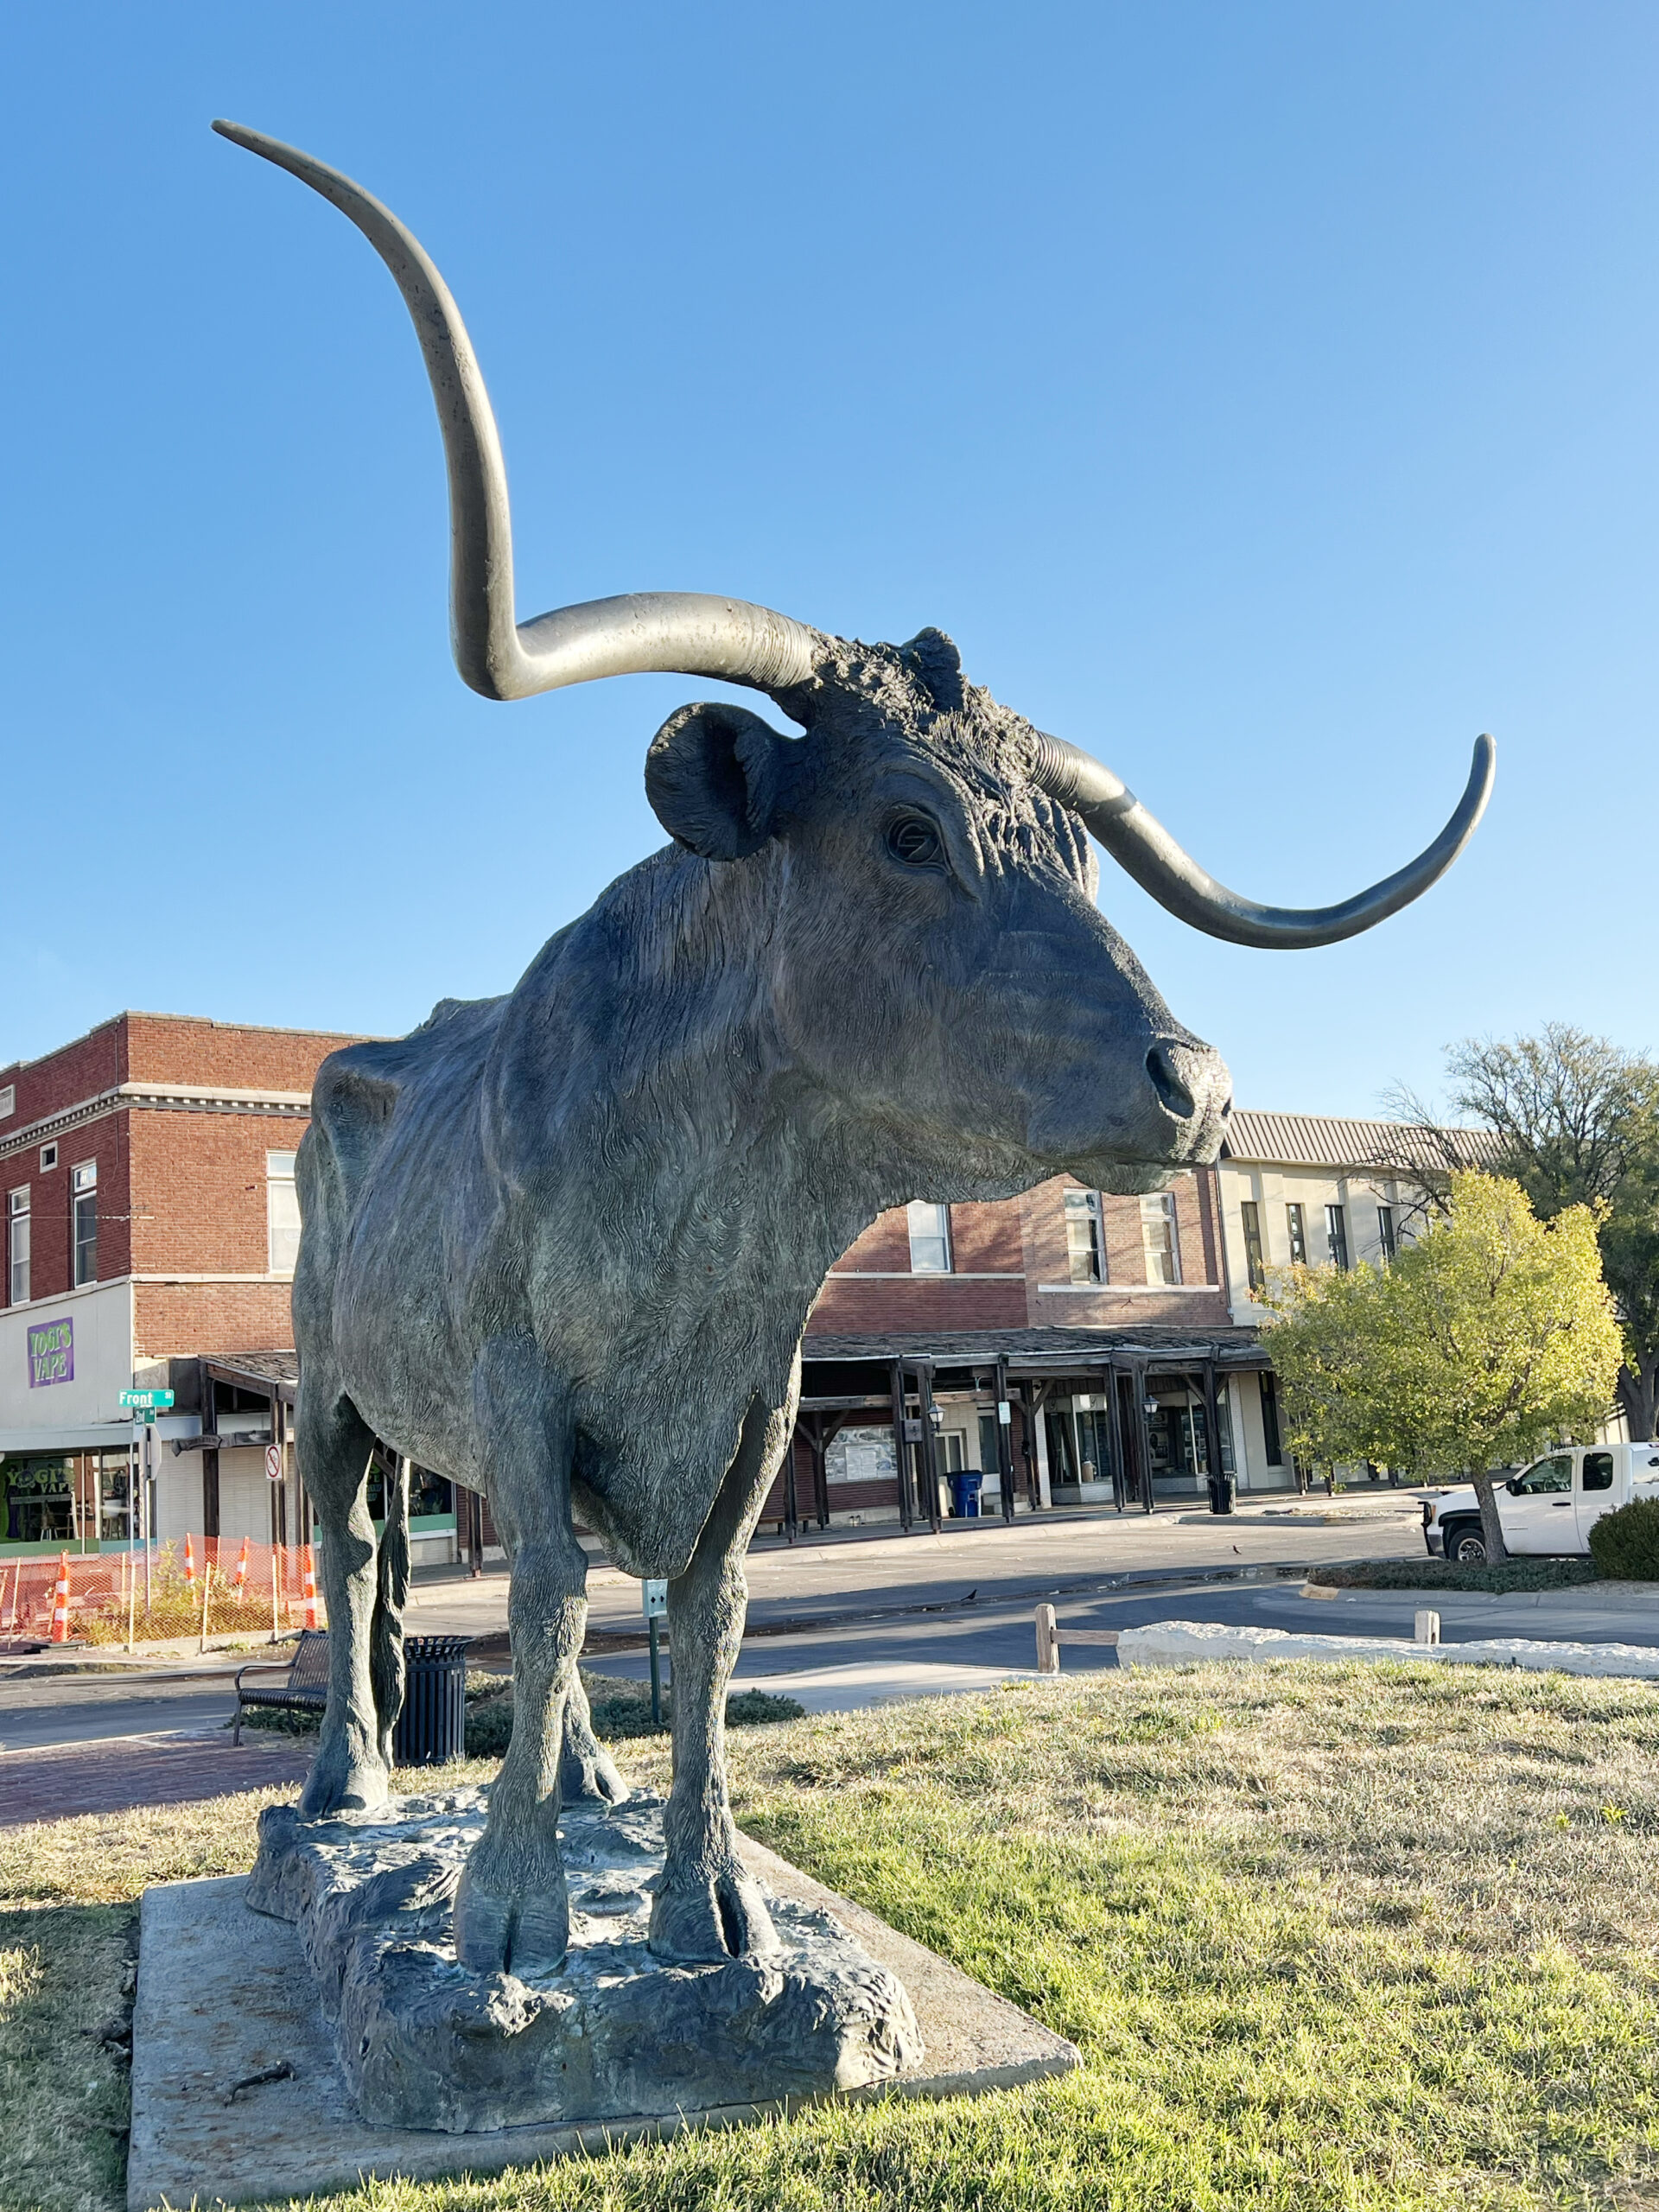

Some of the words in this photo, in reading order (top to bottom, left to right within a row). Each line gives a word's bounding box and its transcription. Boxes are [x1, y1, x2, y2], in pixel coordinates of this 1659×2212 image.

[29, 1323, 72, 1357] YOGI'S
[34, 1352, 67, 1382] VAPE
[119, 1391, 153, 1405] Front
